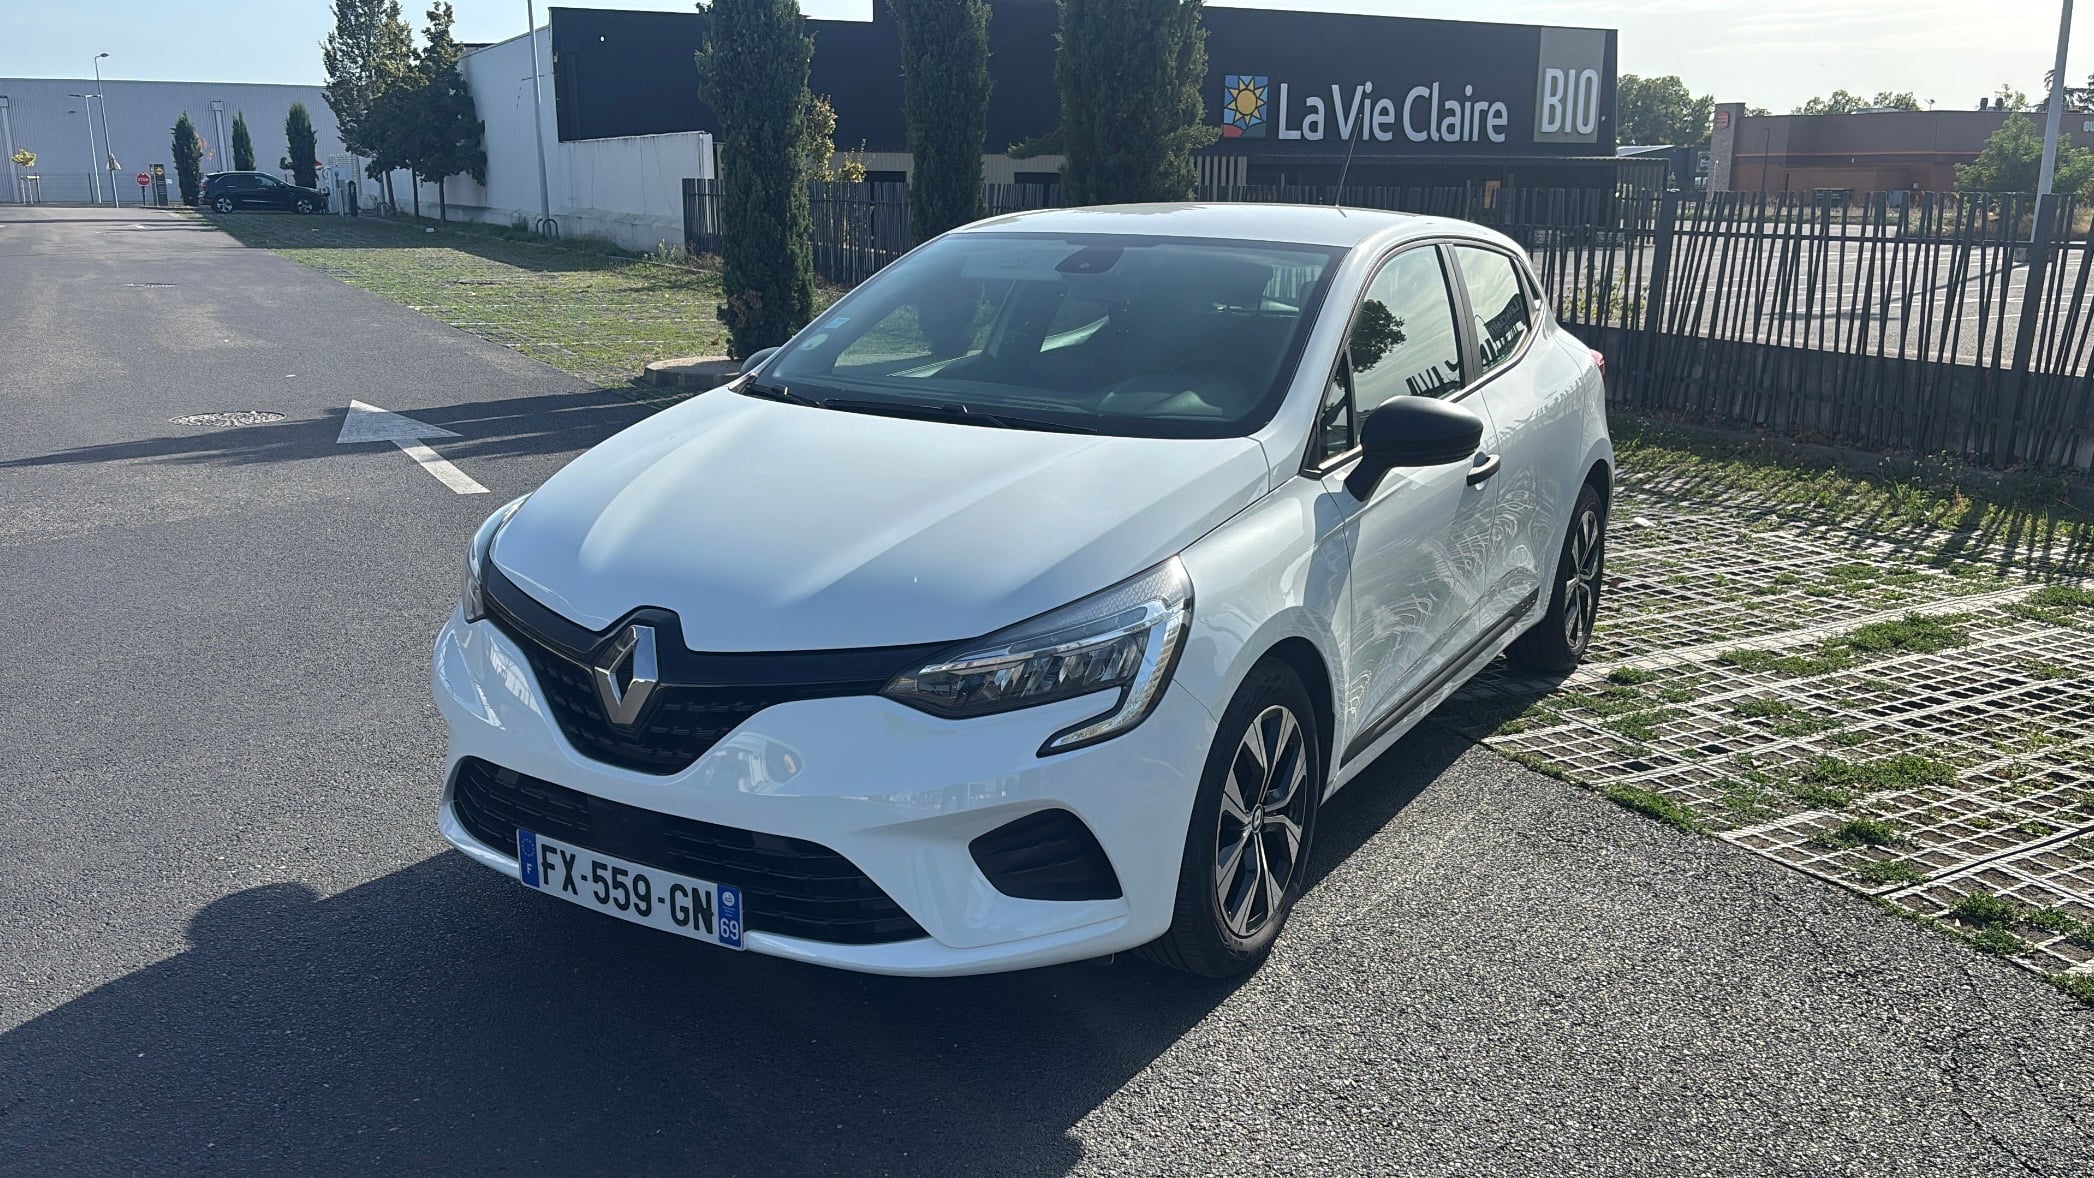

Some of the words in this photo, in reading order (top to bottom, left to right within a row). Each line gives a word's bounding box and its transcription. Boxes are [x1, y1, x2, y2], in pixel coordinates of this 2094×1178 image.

[1278, 83, 1325, 141] La
[1331, 81, 1396, 142] Vie
[1402, 81, 1508, 143] Claire
[1541, 67, 1599, 135] BIO
[526, 862, 533, 875] F
[541, 843, 714, 935] FX-559-GN
[720, 917, 739, 940] 69
